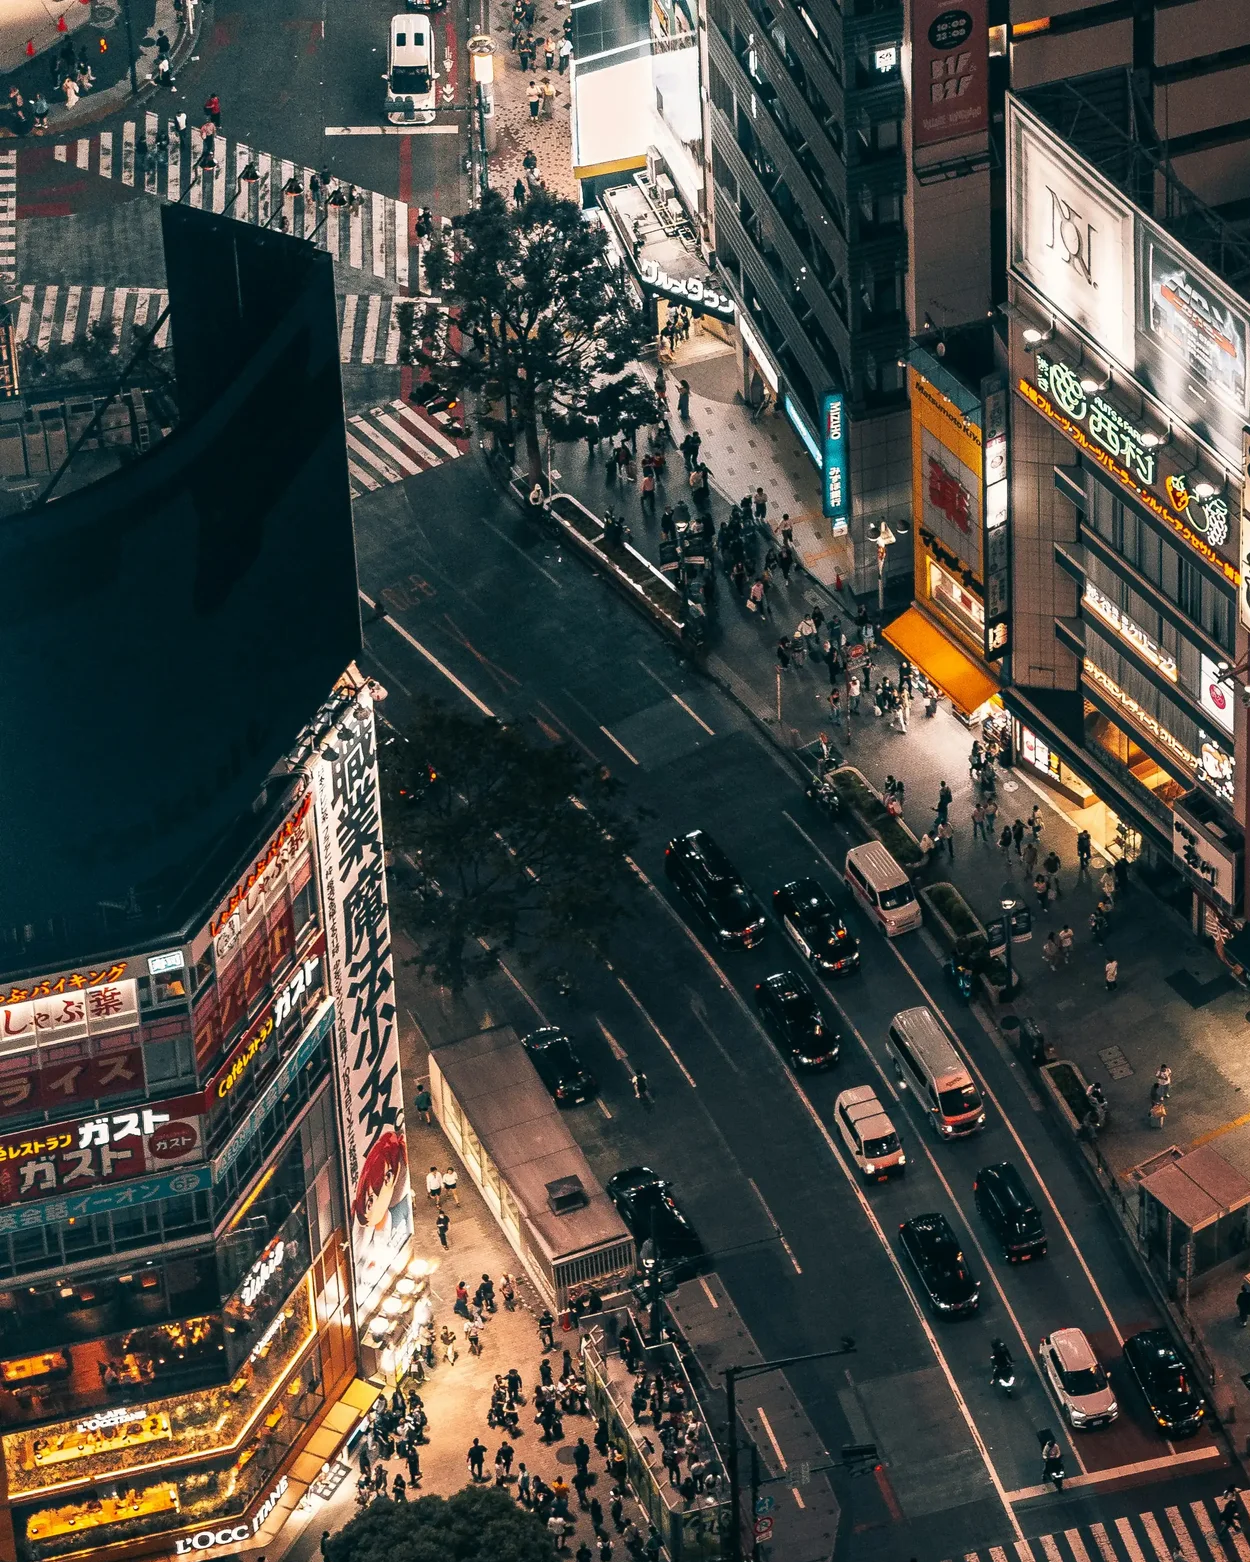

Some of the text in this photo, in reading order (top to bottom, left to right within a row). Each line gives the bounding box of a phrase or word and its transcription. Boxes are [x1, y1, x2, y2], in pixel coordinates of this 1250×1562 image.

[641, 258, 736, 314] グルメタウン
[829, 401, 842, 440] MIZUHO
[4, 986, 124, 1036] しゃぶ葉
[274, 957, 319, 1029] ガスト
[78, 1108, 170, 1149] ガスト
[155, 1136, 192, 1152] ガスト
[20, 1144, 132, 1195] ガスト
